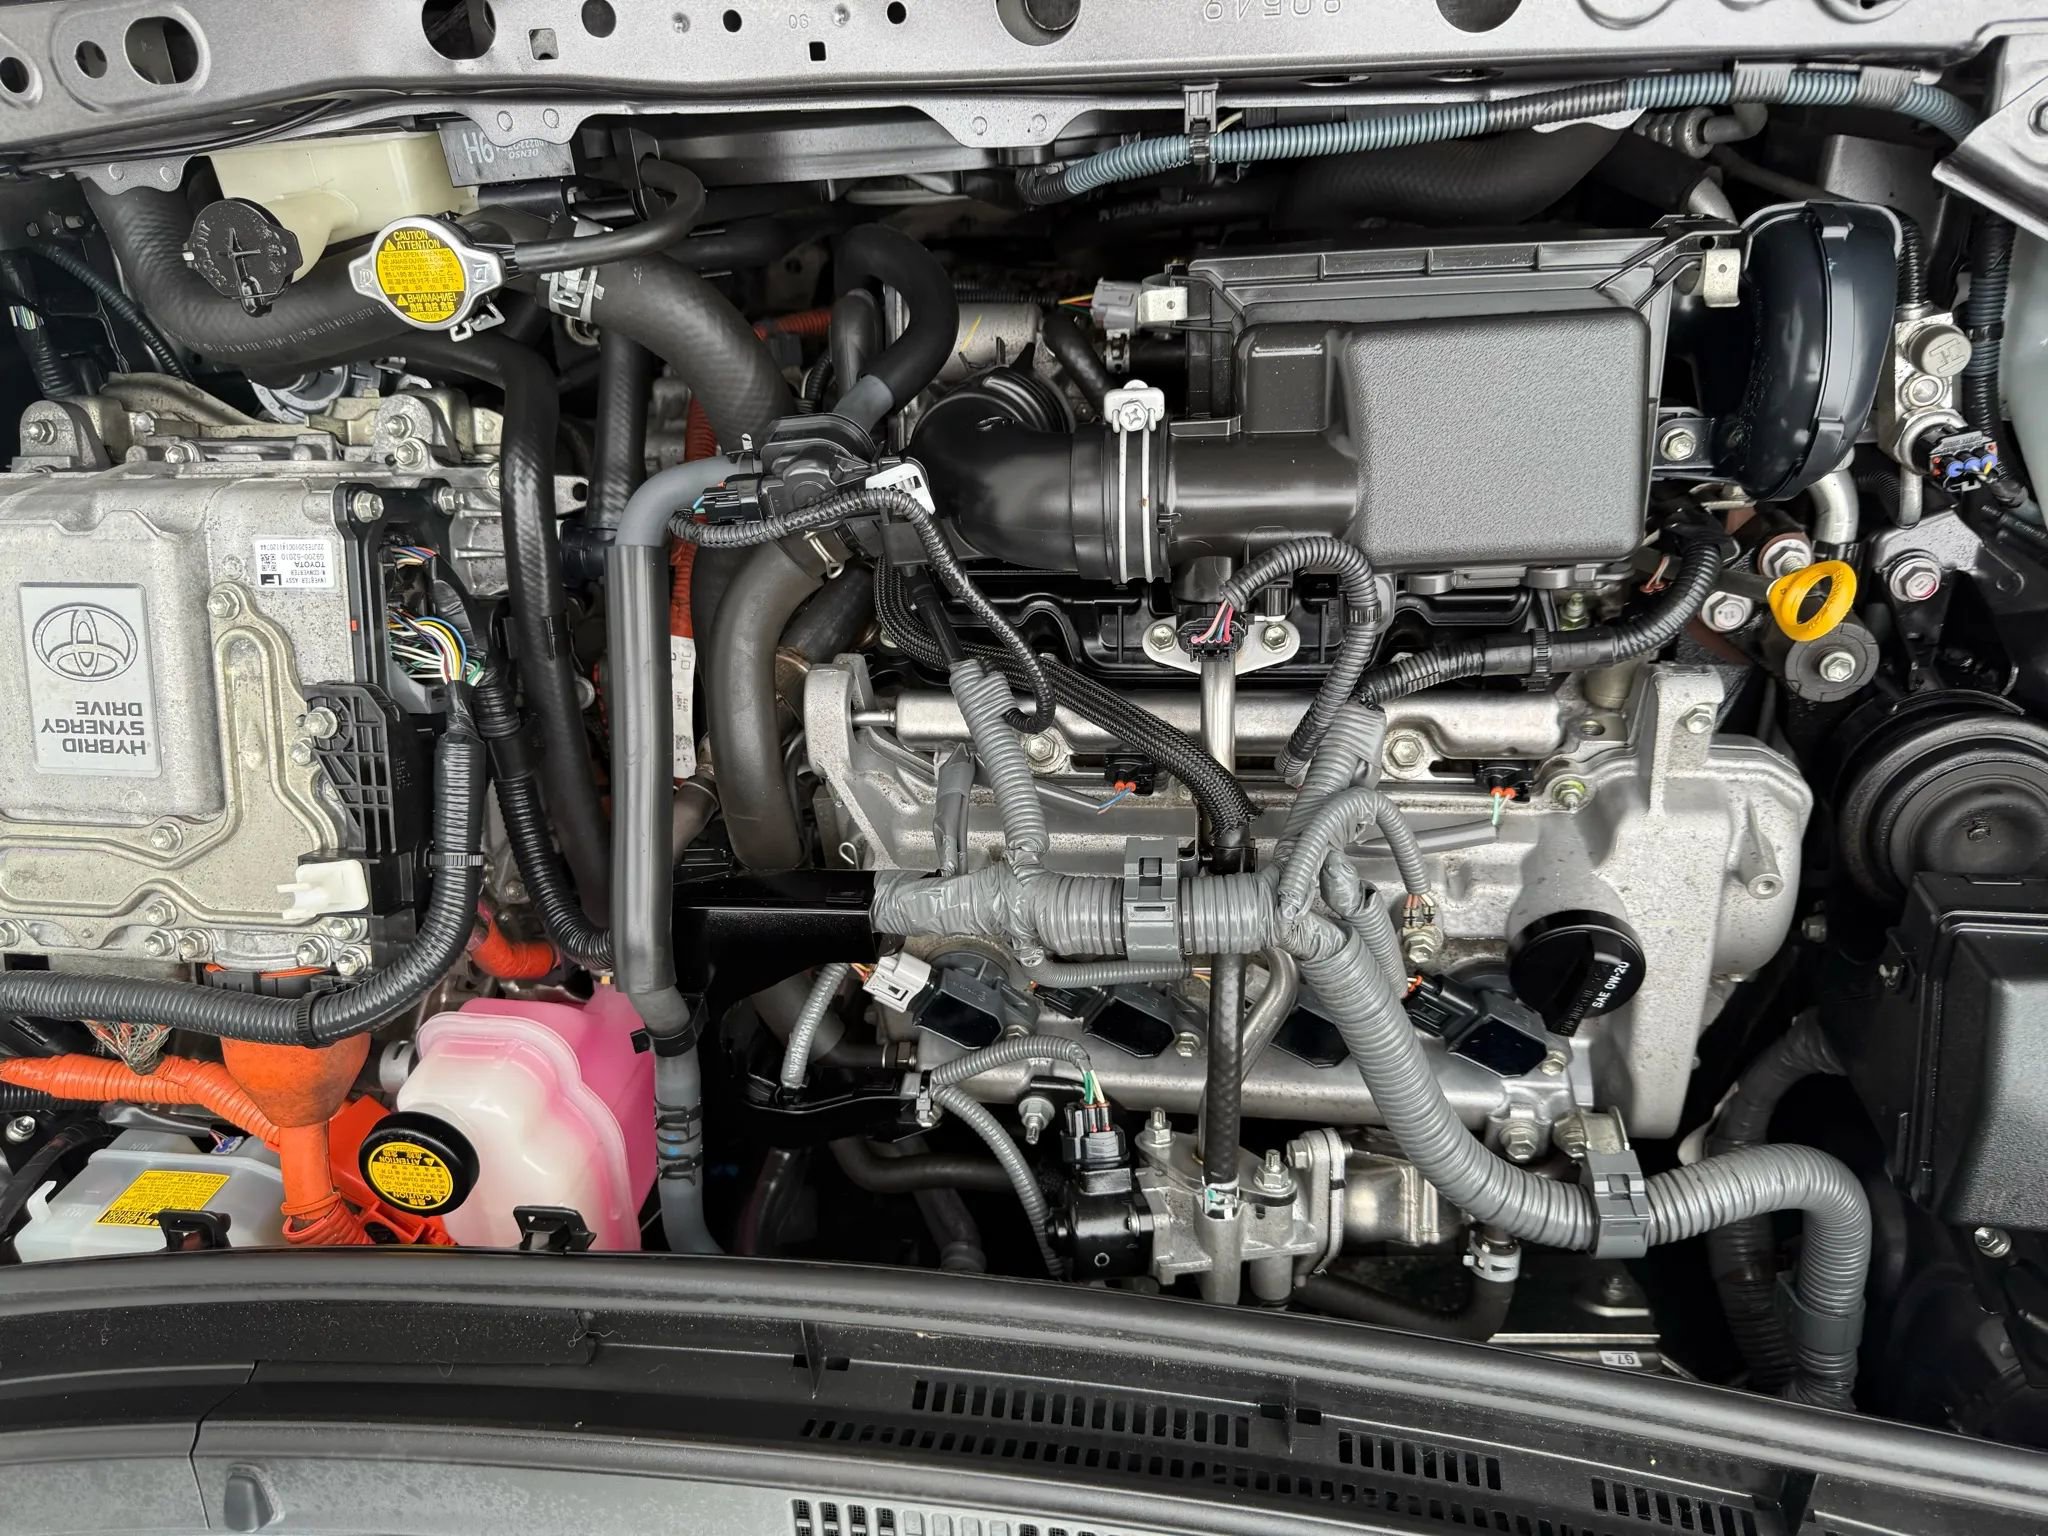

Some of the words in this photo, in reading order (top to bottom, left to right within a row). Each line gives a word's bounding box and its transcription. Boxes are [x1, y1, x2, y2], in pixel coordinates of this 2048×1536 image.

[508, 148, 538, 160] DENSO
[394, 230, 428, 240] CAUTION
[397, 240, 440, 250] ATTENTION
[75, 701, 143, 716] DRIVE
[40, 718, 145, 736] SYNERGY
[62, 738, 147, 755] HYBRID
[1591, 991, 1611, 1009] SAE
[1604, 961, 1630, 990] 0W-20
[379, 1155, 420, 1166] ATTENTION
[392, 1191, 432, 1201] CAUTION
